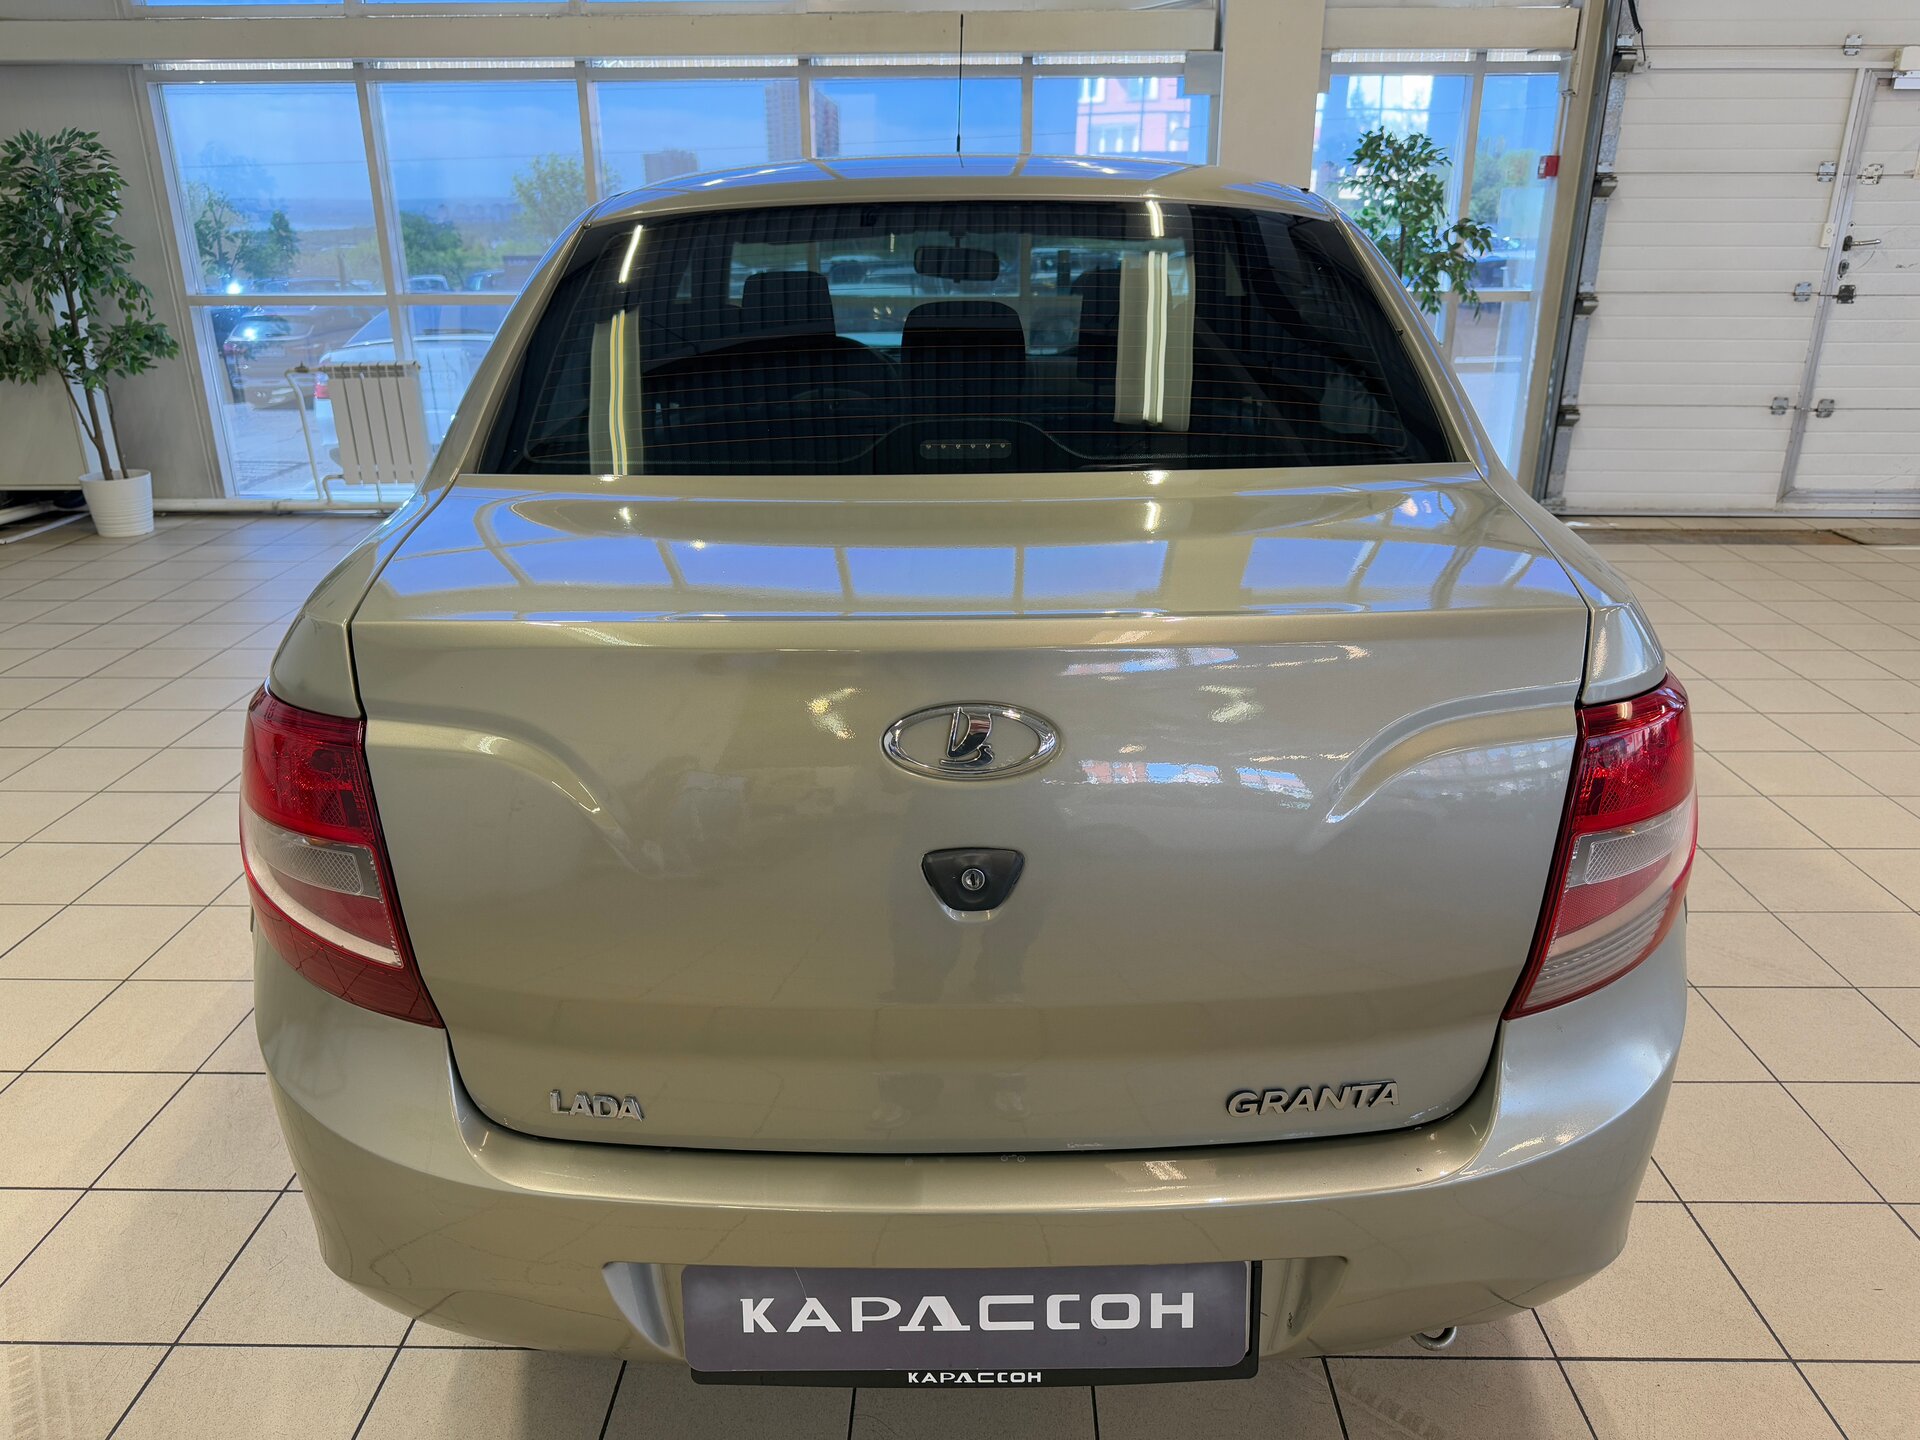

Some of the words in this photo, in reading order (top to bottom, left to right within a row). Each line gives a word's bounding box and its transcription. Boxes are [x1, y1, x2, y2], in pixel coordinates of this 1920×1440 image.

[549, 1090, 643, 1122] LADA
[1227, 1082, 1399, 1117] GRANTA
[740, 1292, 1194, 1333] КАРАССОН
[908, 1371, 1041, 1384] КАРАССОН
